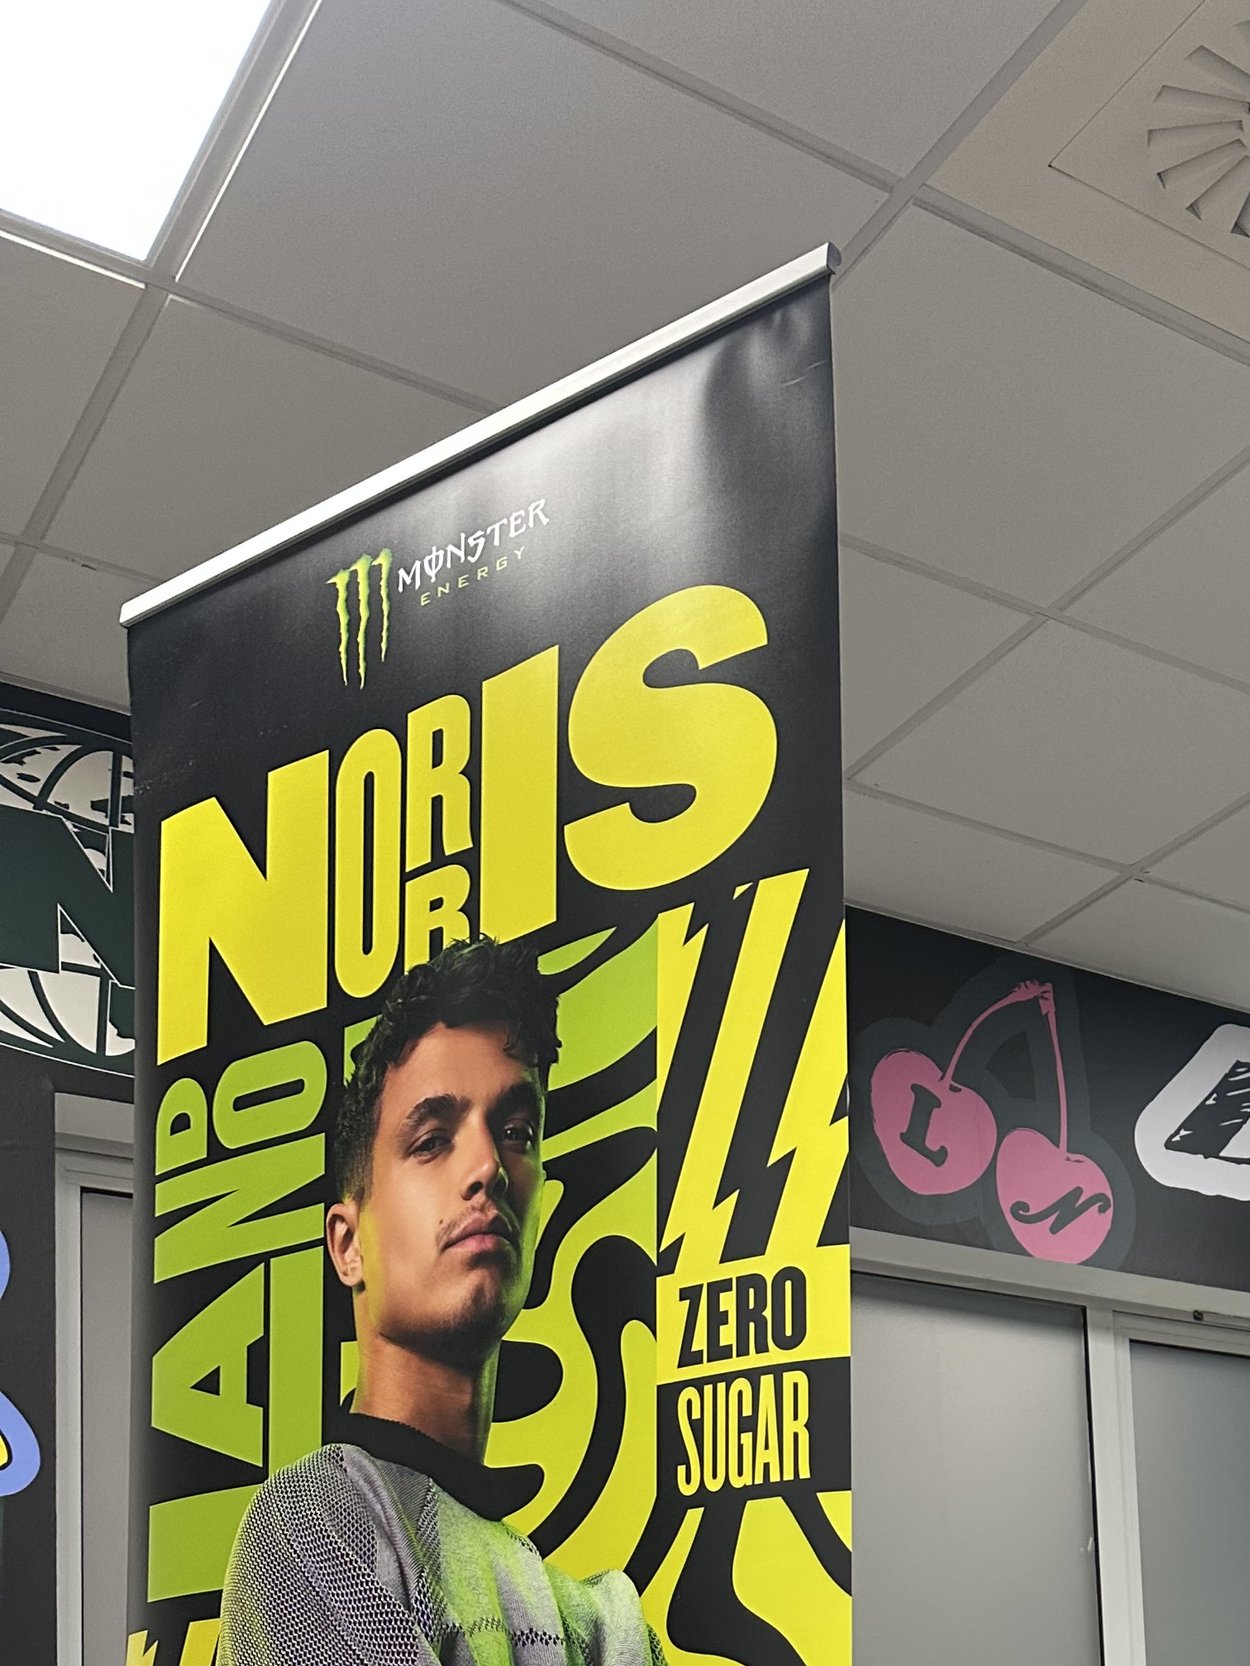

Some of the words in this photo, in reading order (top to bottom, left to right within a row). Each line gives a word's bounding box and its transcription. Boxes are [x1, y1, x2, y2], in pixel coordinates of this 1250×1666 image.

[398, 499, 549, 593] MONSTER
[420, 547, 525, 606] ENERGY
[676, 1266, 808, 1369] ZERO
[677, 1370, 811, 1497] SUGAR
